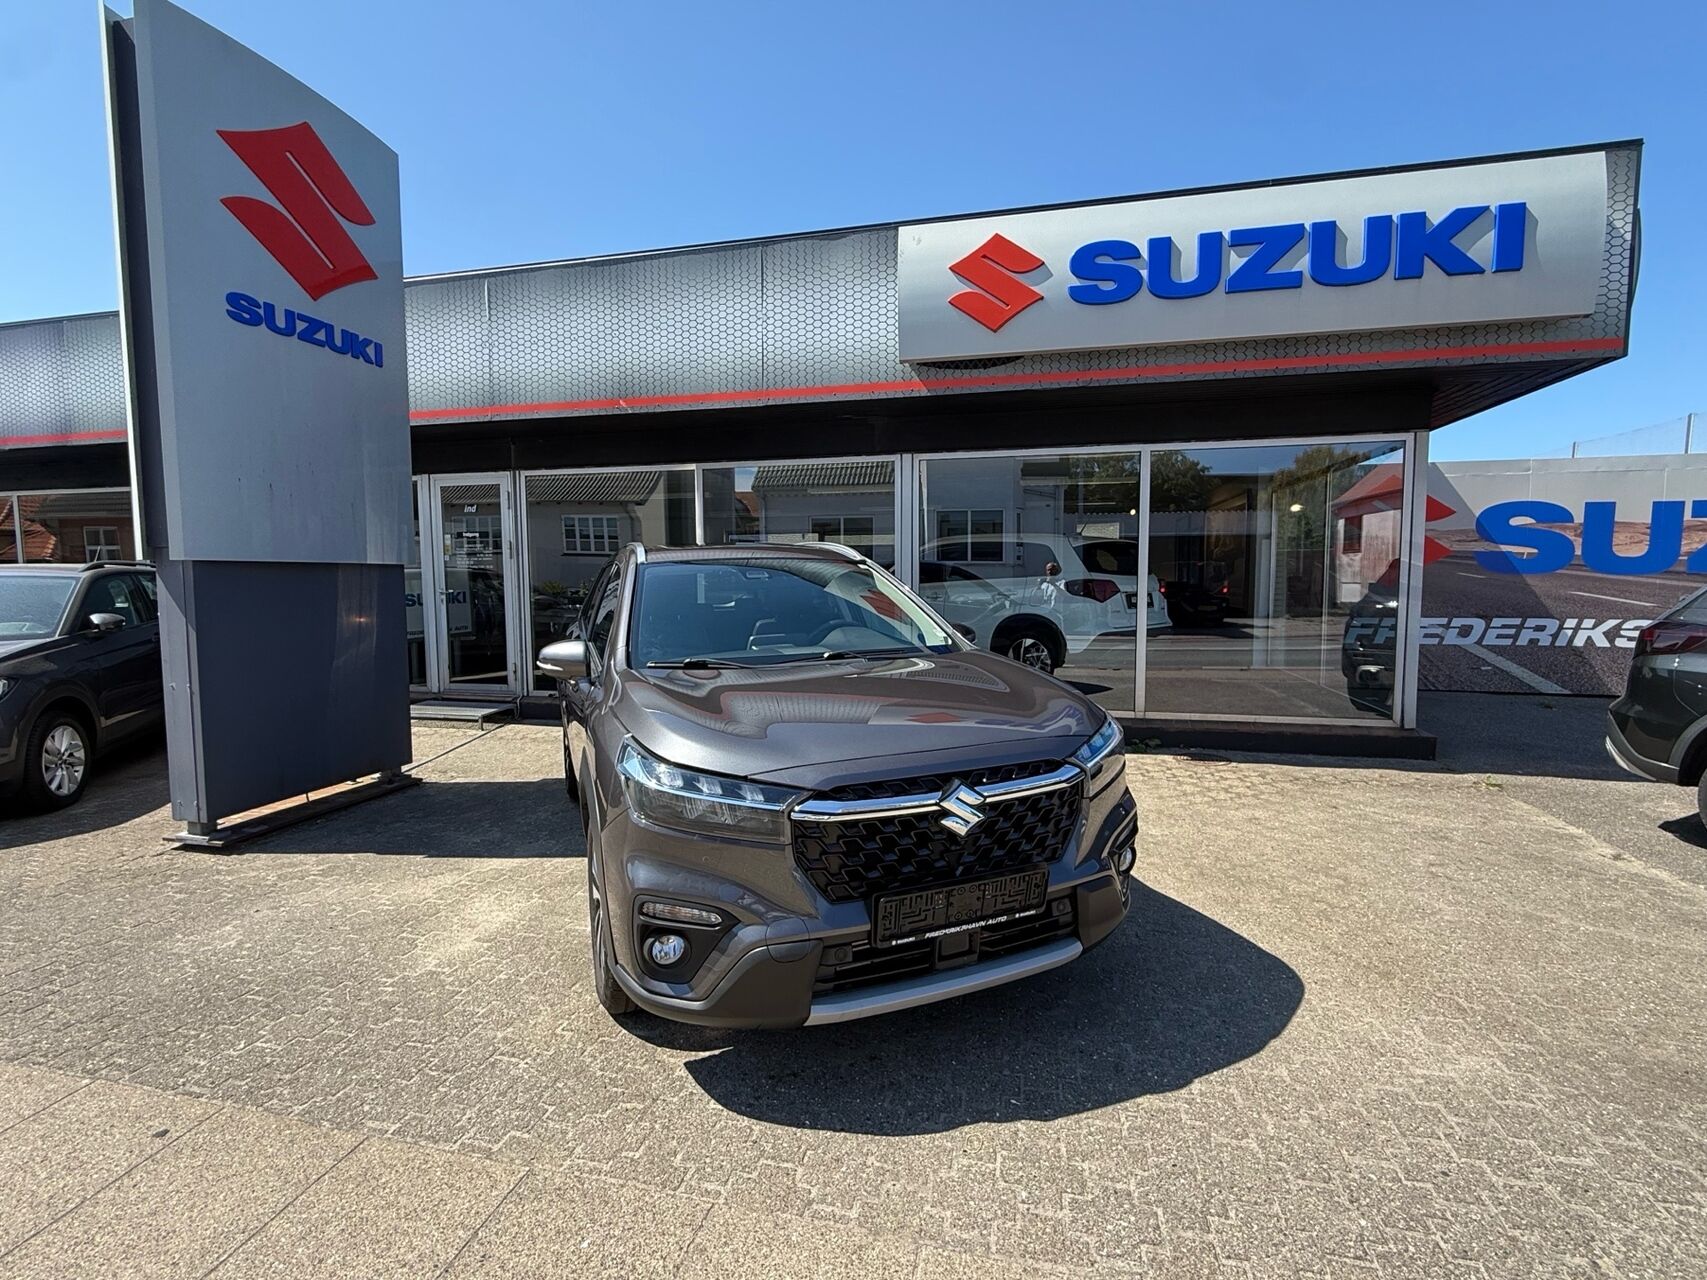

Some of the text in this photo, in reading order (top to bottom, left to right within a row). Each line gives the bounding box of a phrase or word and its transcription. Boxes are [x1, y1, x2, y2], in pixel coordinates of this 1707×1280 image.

[1067, 202, 1528, 305] SUZUKI
[225, 291, 384, 368] SUZUKI
[1474, 499, 1707, 576] SU
